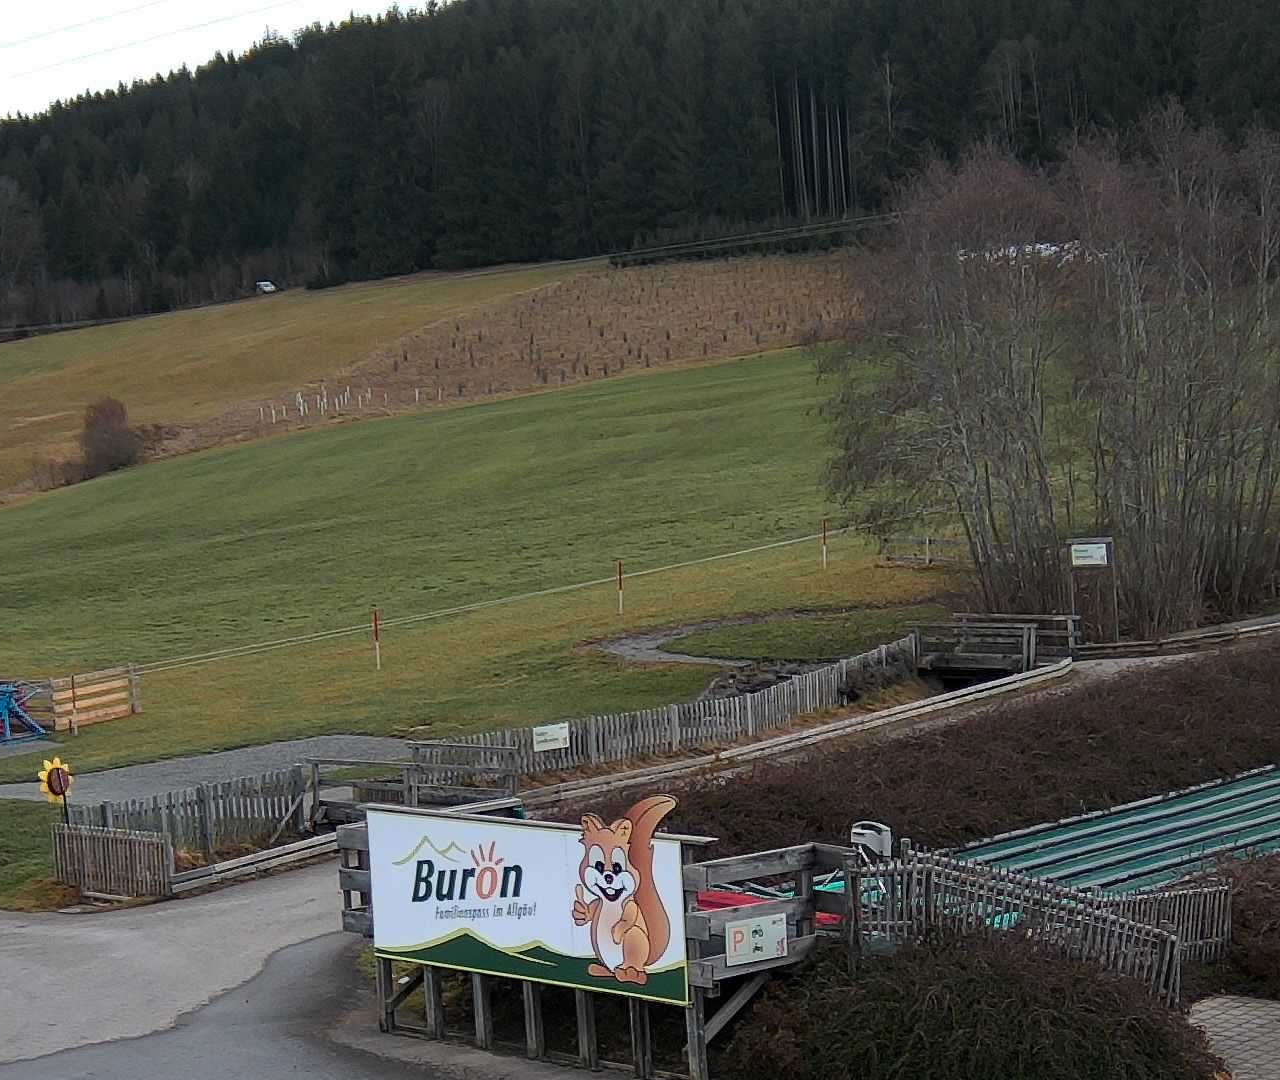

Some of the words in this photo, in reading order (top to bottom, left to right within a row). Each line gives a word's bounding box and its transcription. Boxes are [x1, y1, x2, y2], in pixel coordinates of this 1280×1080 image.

[411, 859, 523, 902] Buron
[493, 904, 503, 917] im
[733, 929, 745, 953] P
